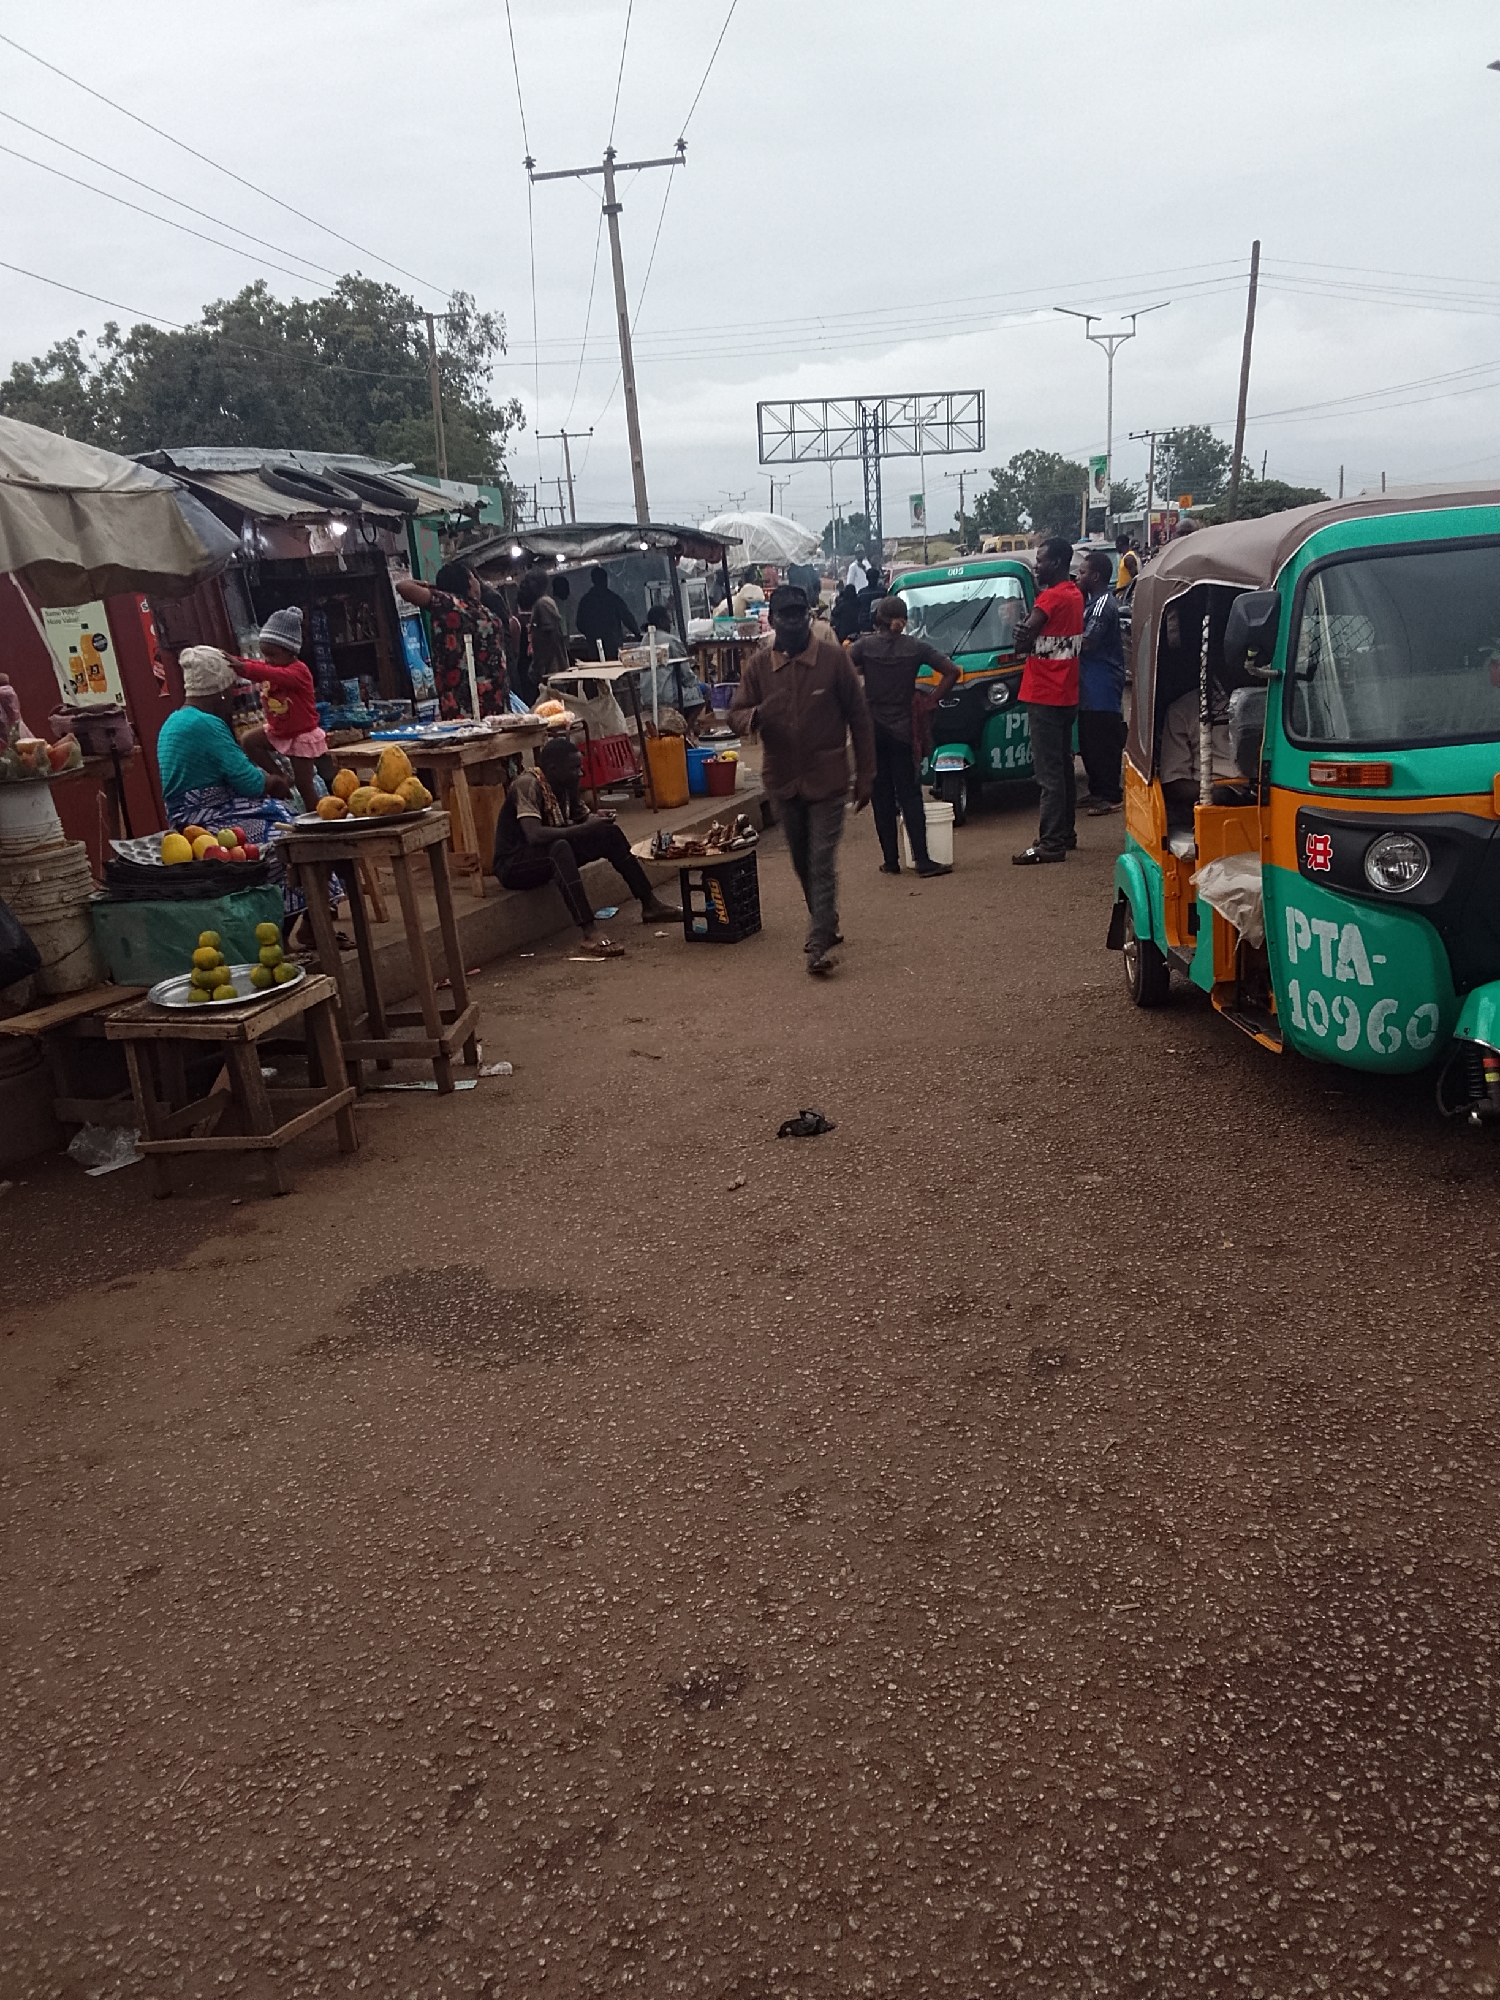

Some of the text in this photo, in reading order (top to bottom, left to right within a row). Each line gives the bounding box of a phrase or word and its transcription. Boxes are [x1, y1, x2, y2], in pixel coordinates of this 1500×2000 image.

[1006, 713, 1031, 739] PT
[1286, 906, 1387, 986] PTA-
[1288, 979, 1440, 1054] 10960
